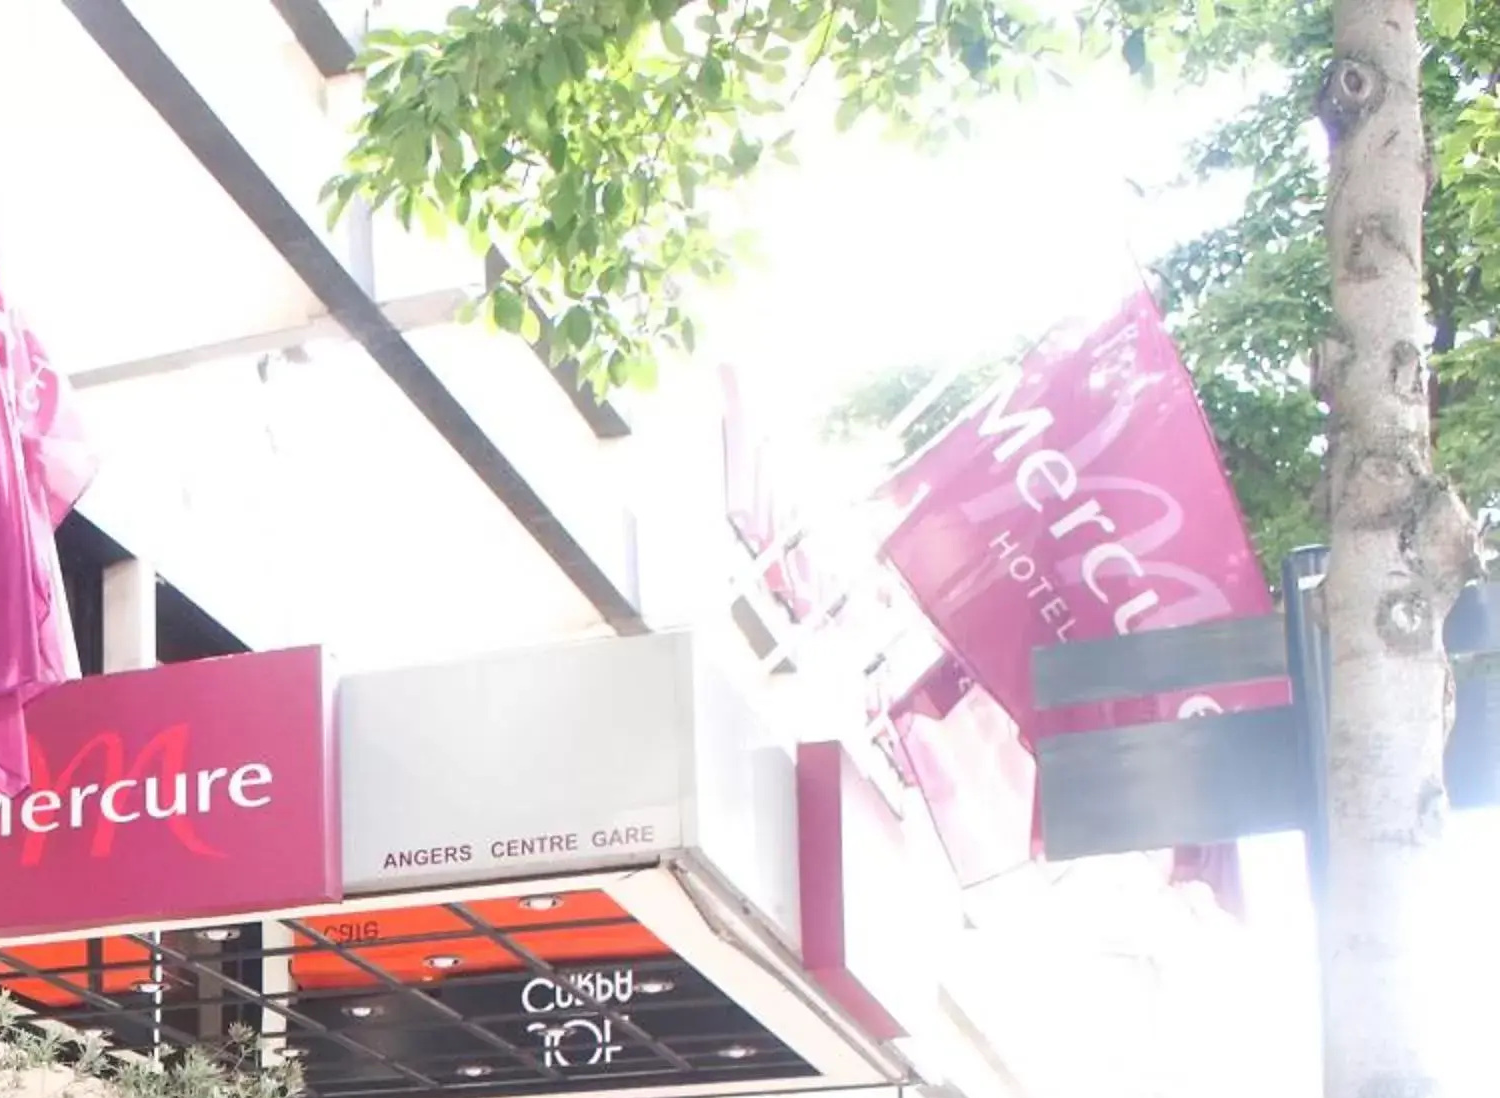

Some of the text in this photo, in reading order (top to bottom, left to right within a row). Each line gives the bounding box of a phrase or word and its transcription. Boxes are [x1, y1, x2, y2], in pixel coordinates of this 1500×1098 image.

[383, 825, 654, 869] ANGERS CENTRE GARE
